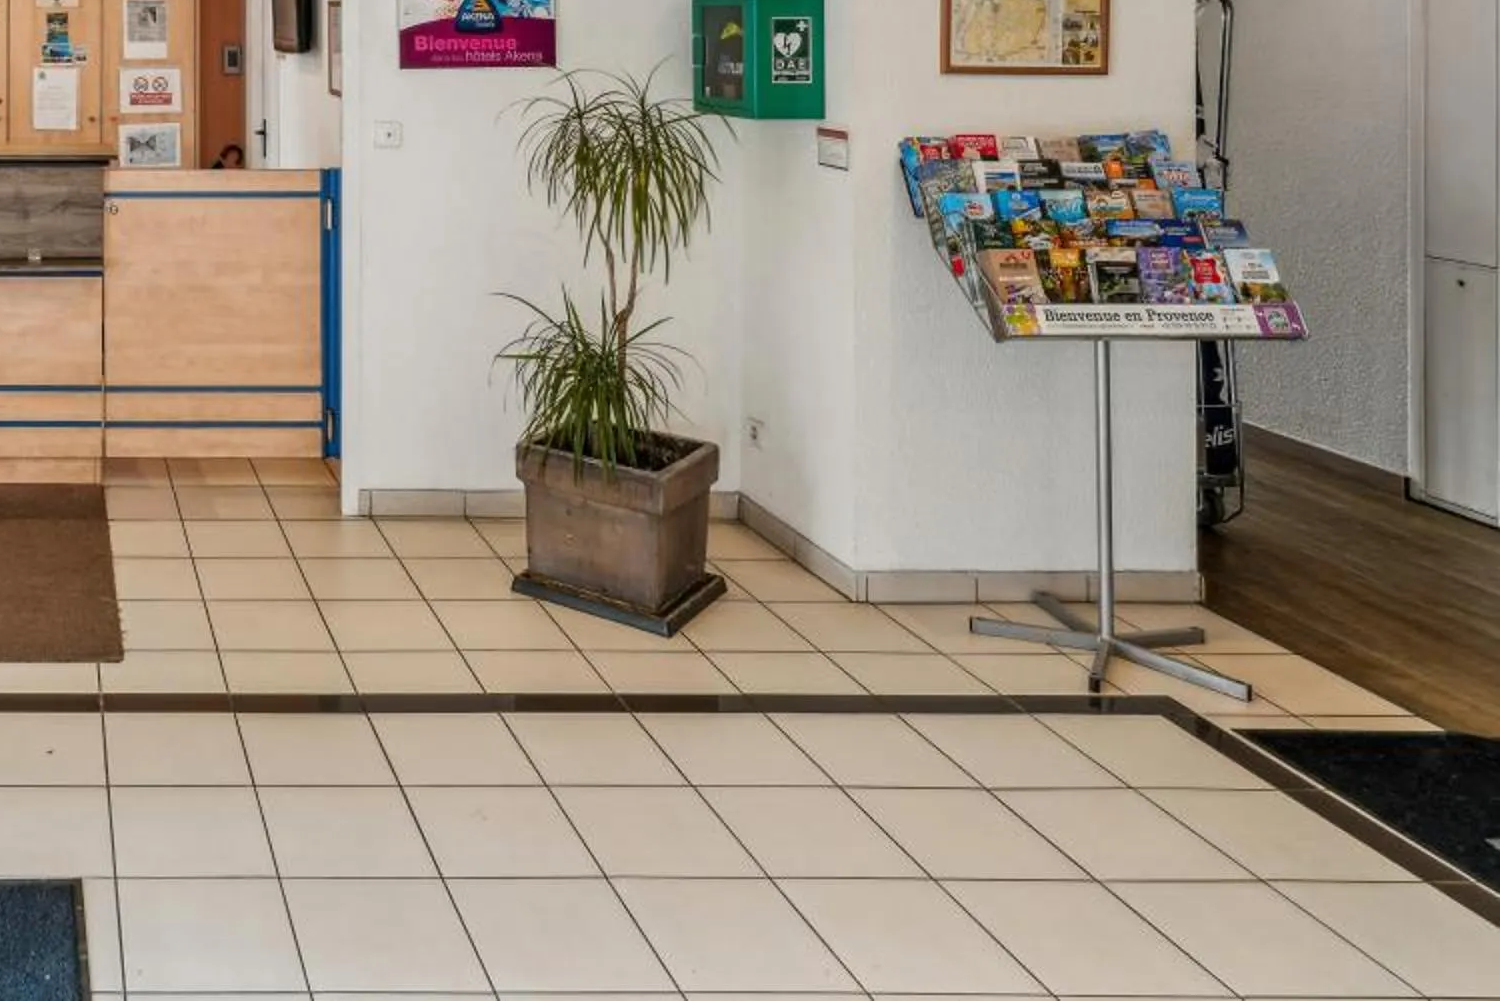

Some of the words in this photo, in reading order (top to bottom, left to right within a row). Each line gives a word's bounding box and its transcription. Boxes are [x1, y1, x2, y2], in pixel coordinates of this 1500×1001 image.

[414, 35, 517, 51] Bienvenue
[775, 59, 806, 70] DAE
[1043, 308, 1121, 322] Bienvenue
[1124, 312, 1142, 322] en
[1145, 307, 1215, 322] Provence
